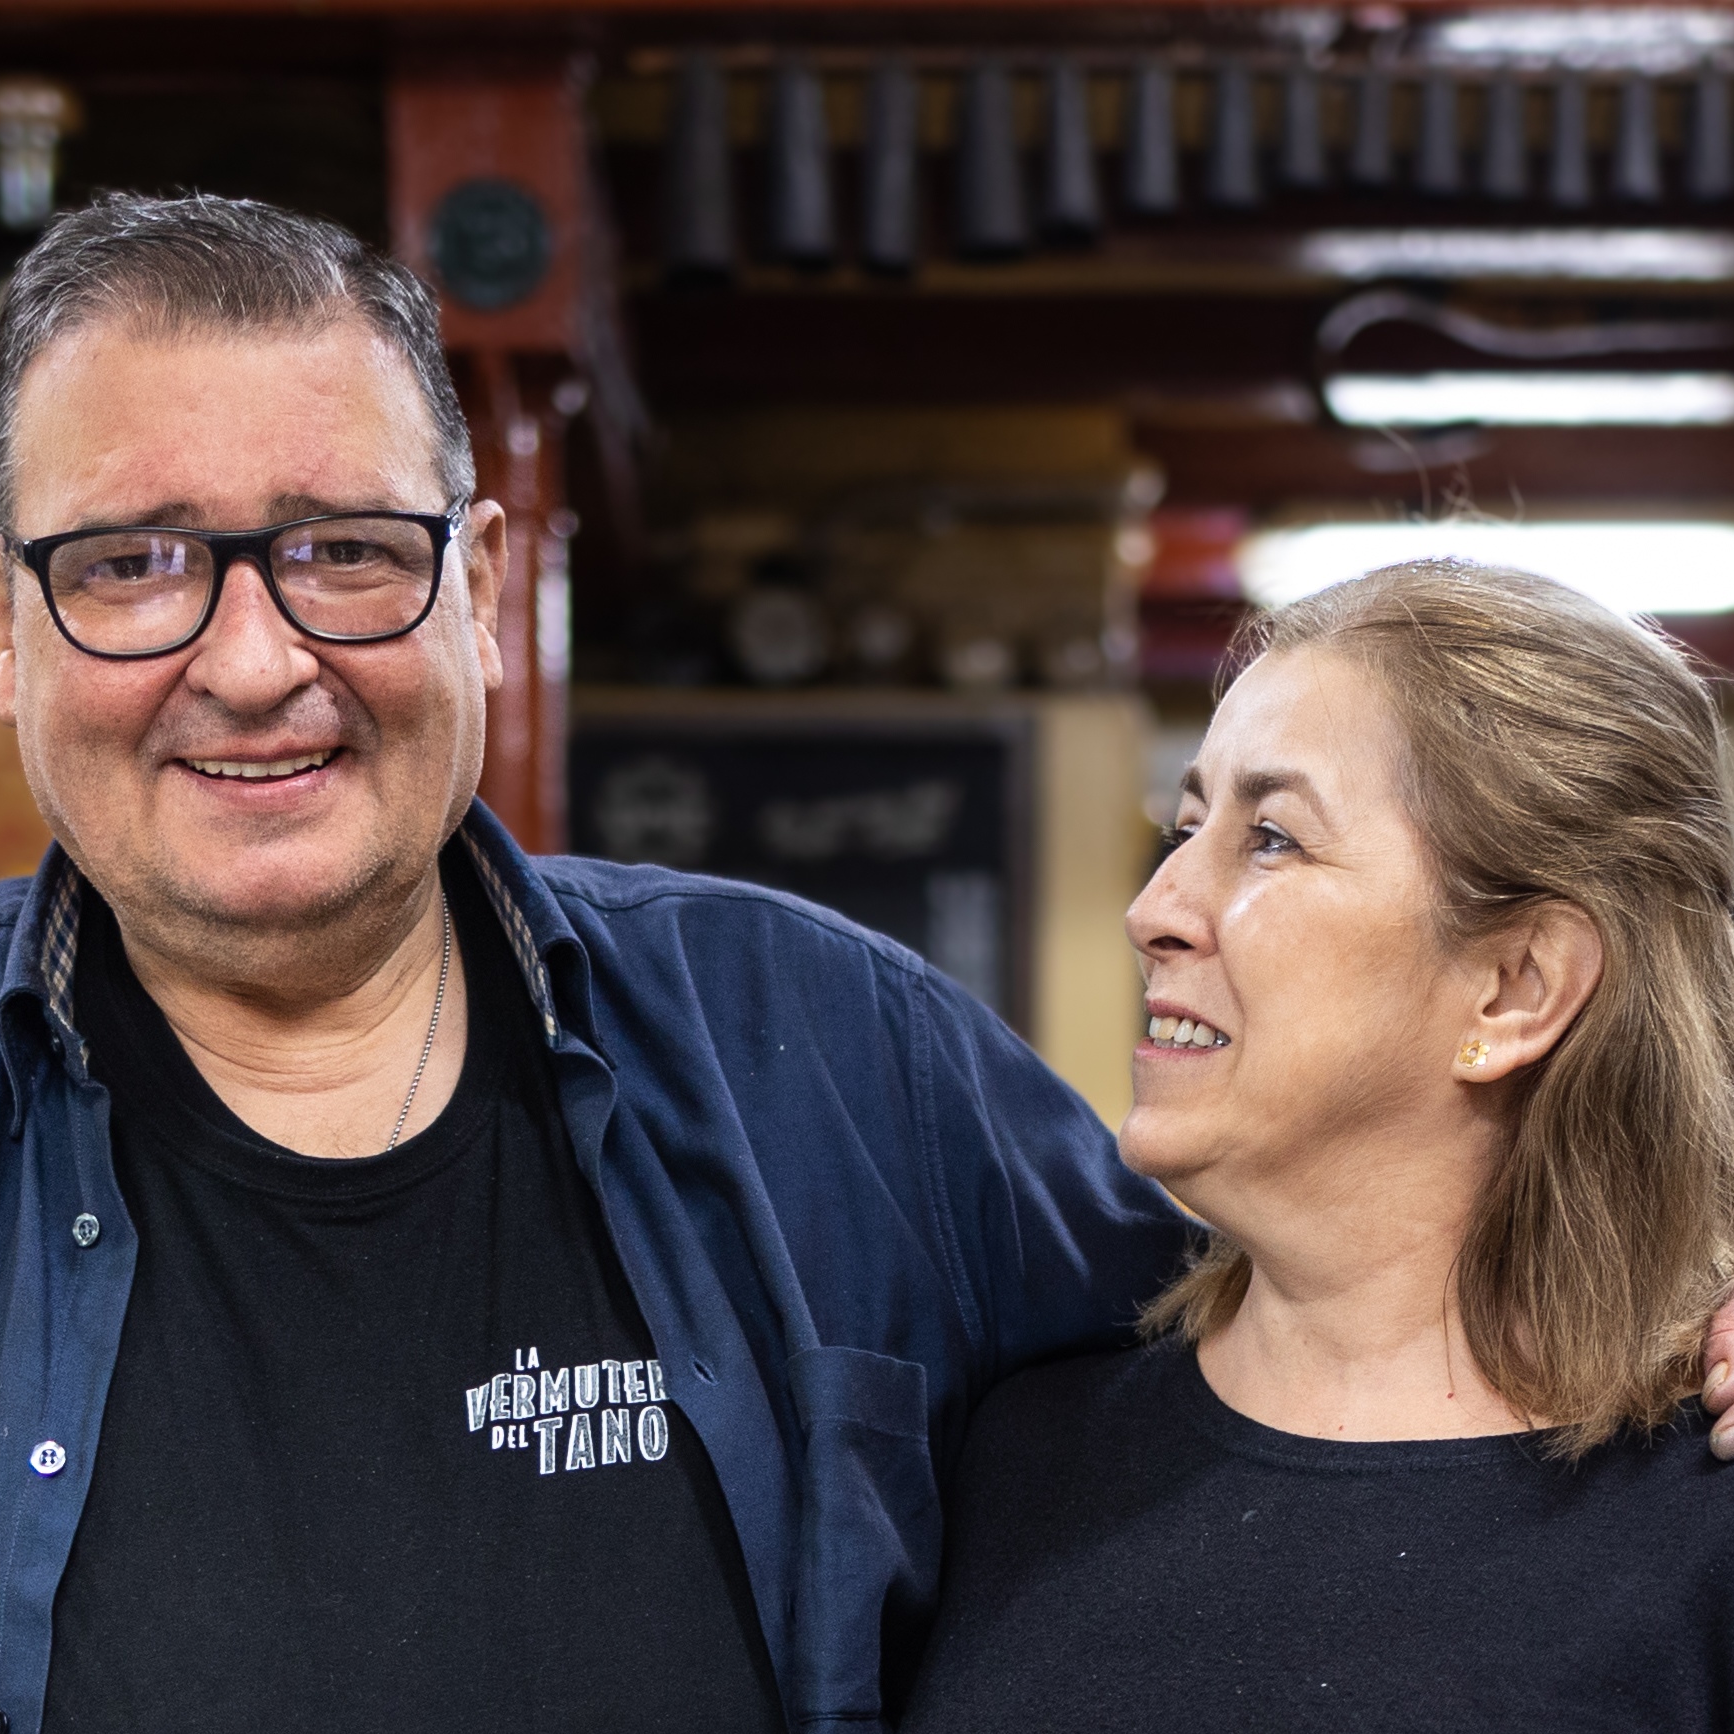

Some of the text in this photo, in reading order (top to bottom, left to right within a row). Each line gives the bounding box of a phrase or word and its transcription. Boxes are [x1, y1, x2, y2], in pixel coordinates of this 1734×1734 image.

[515, 1346, 540, 1371] LA
[491, 1404, 669, 1477] DEL TANO
